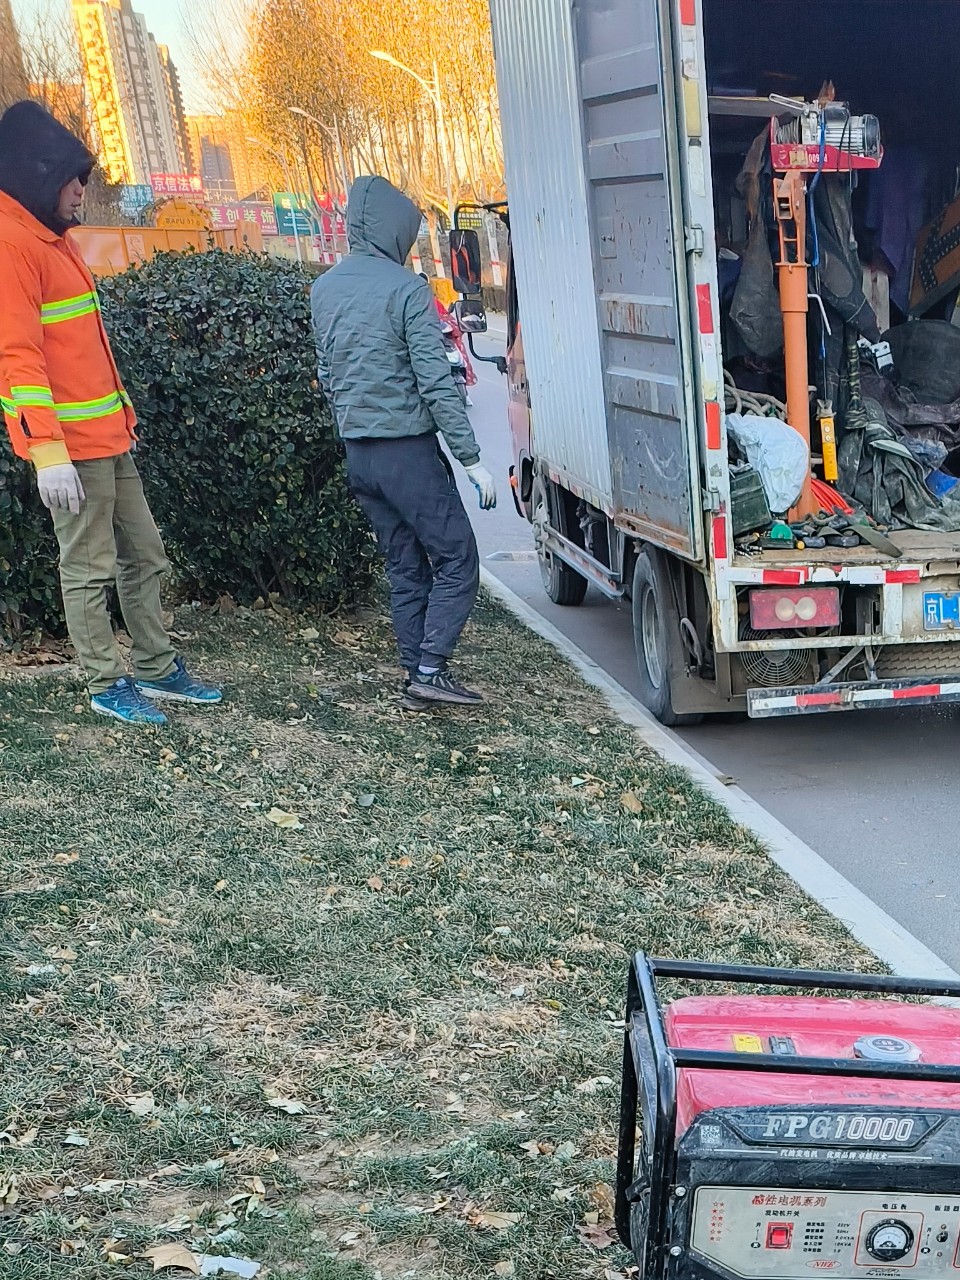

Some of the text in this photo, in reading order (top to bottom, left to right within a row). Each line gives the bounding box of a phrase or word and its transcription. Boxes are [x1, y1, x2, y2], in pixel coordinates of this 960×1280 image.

[152, 176, 202, 192] 京信法律
[210, 207, 275, 225] 美创装饰
[762, 1115, 915, 1142] FPG10000
